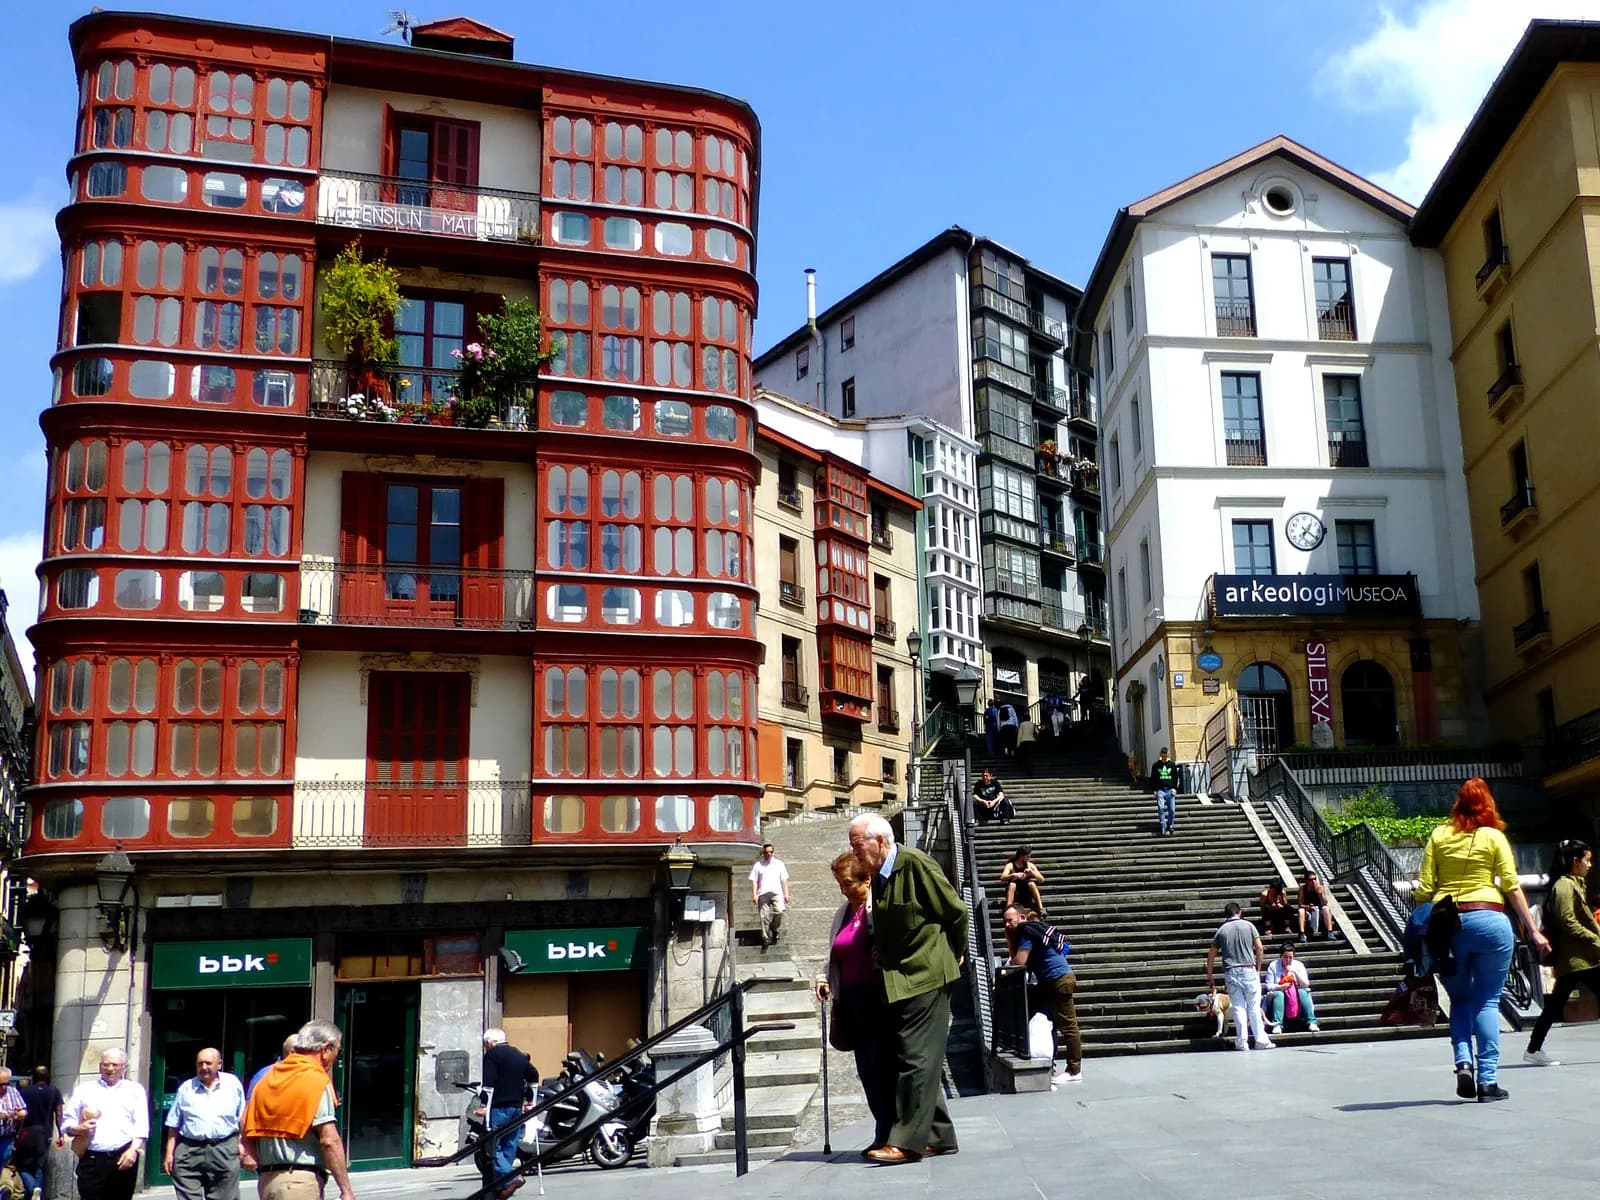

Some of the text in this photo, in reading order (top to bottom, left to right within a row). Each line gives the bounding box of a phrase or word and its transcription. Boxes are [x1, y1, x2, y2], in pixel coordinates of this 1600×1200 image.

[1226, 580, 1408, 606] arkeologi MUSEOA
[547, 941, 607, 959] bbk
[199, 954, 265, 973] bbk
